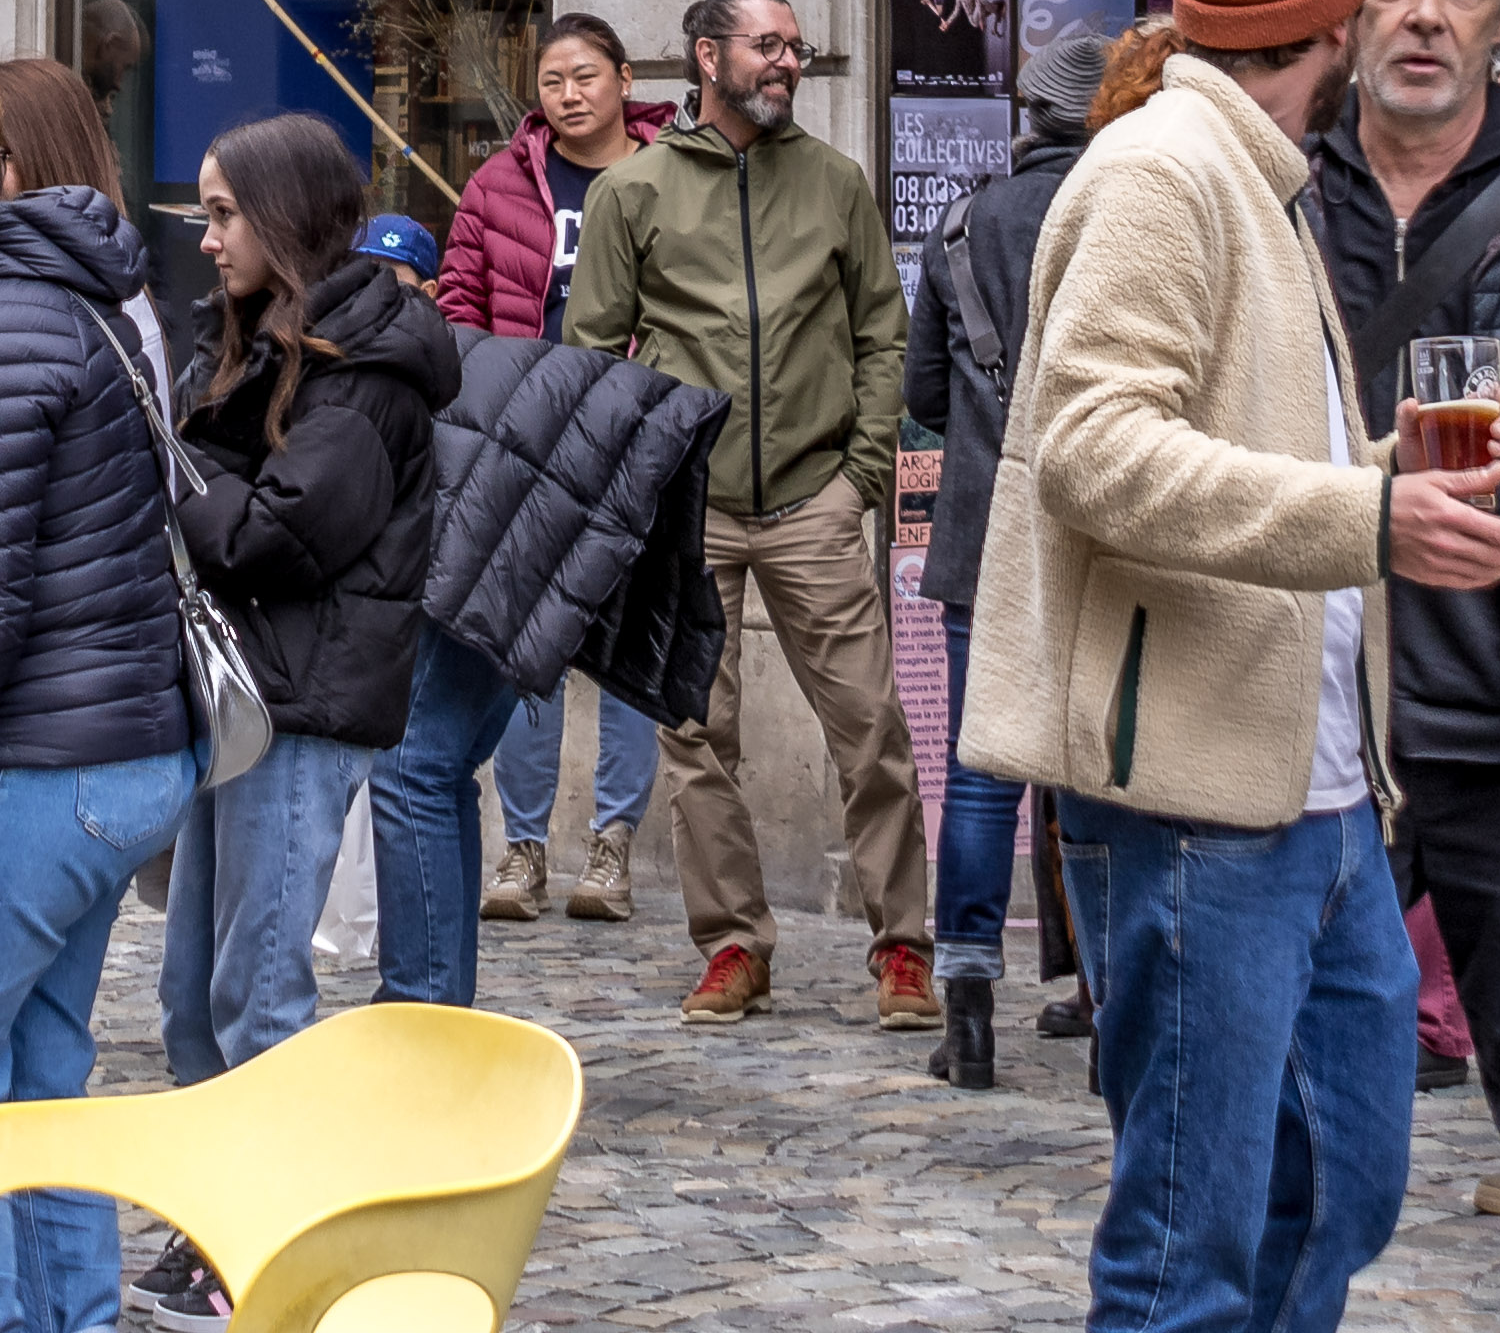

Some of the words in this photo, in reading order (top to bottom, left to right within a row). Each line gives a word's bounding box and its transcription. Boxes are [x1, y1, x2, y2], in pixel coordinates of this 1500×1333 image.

[894, 112, 924, 137] LES
[894, 138, 1005, 165] COLLECTIVES
[894, 204, 943, 233] 03.0
